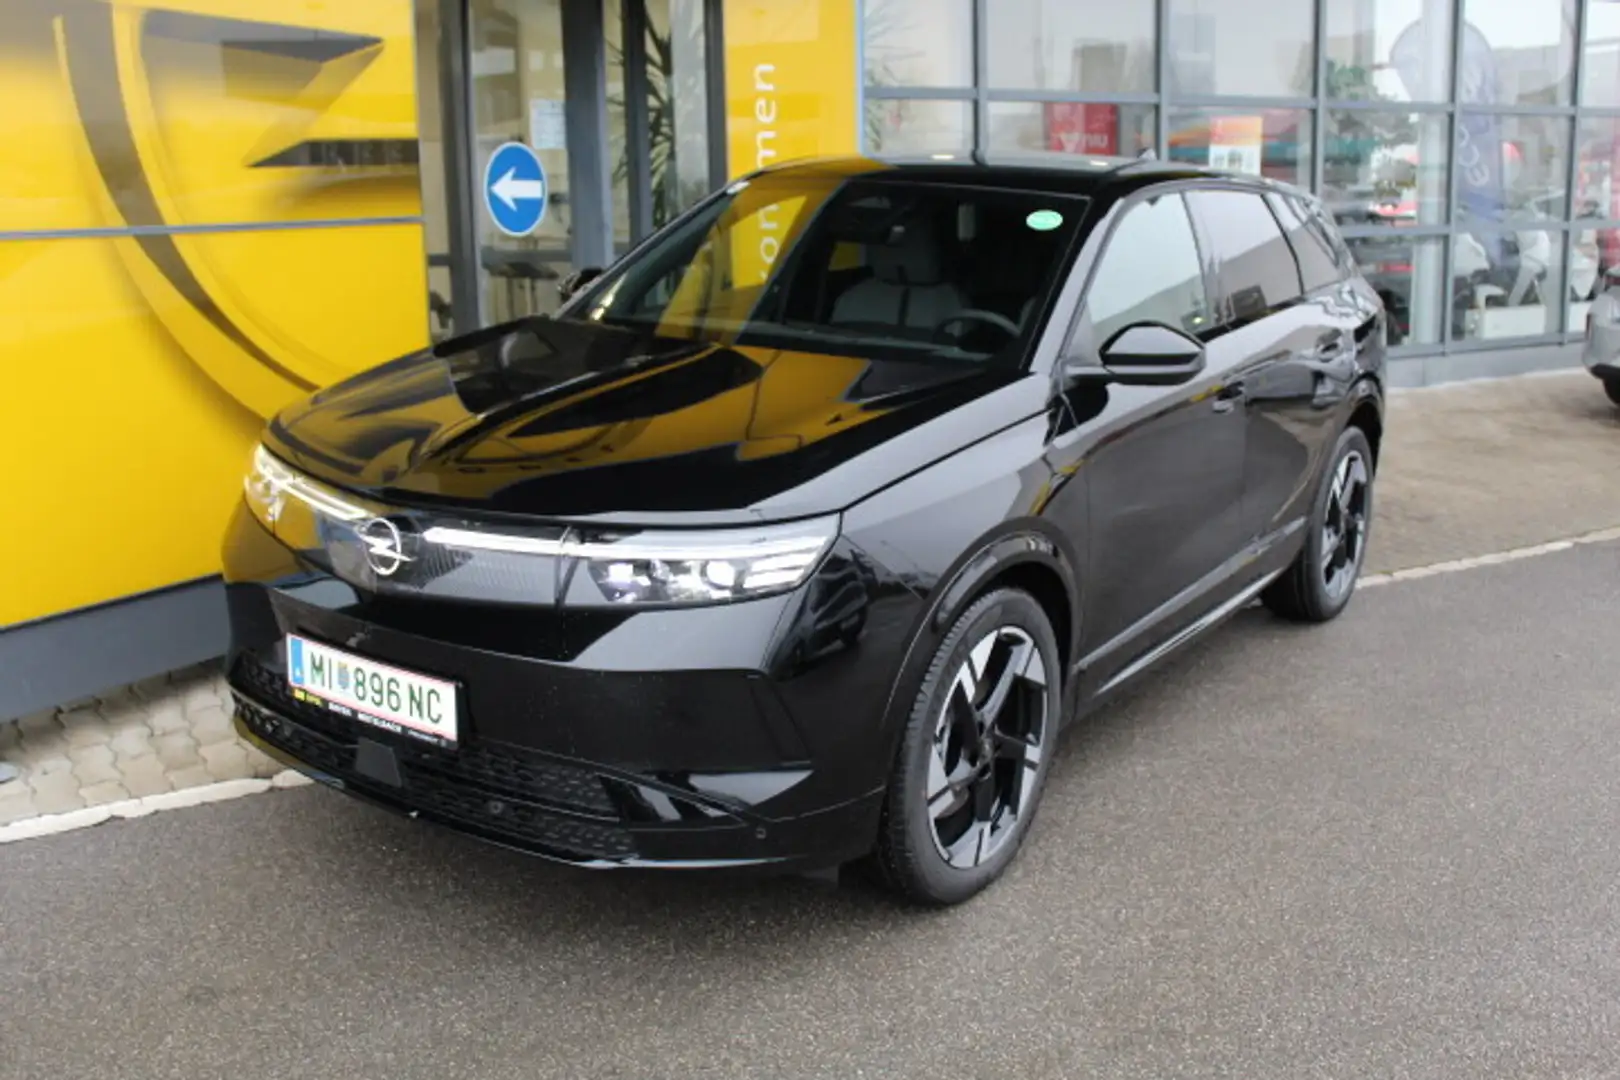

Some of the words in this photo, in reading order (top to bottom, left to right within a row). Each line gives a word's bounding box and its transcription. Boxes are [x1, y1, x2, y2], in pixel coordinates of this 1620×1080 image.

[310, 652, 333, 690] MI
[353, 667, 401, 712] 896
[408, 684, 443, 724] NC
